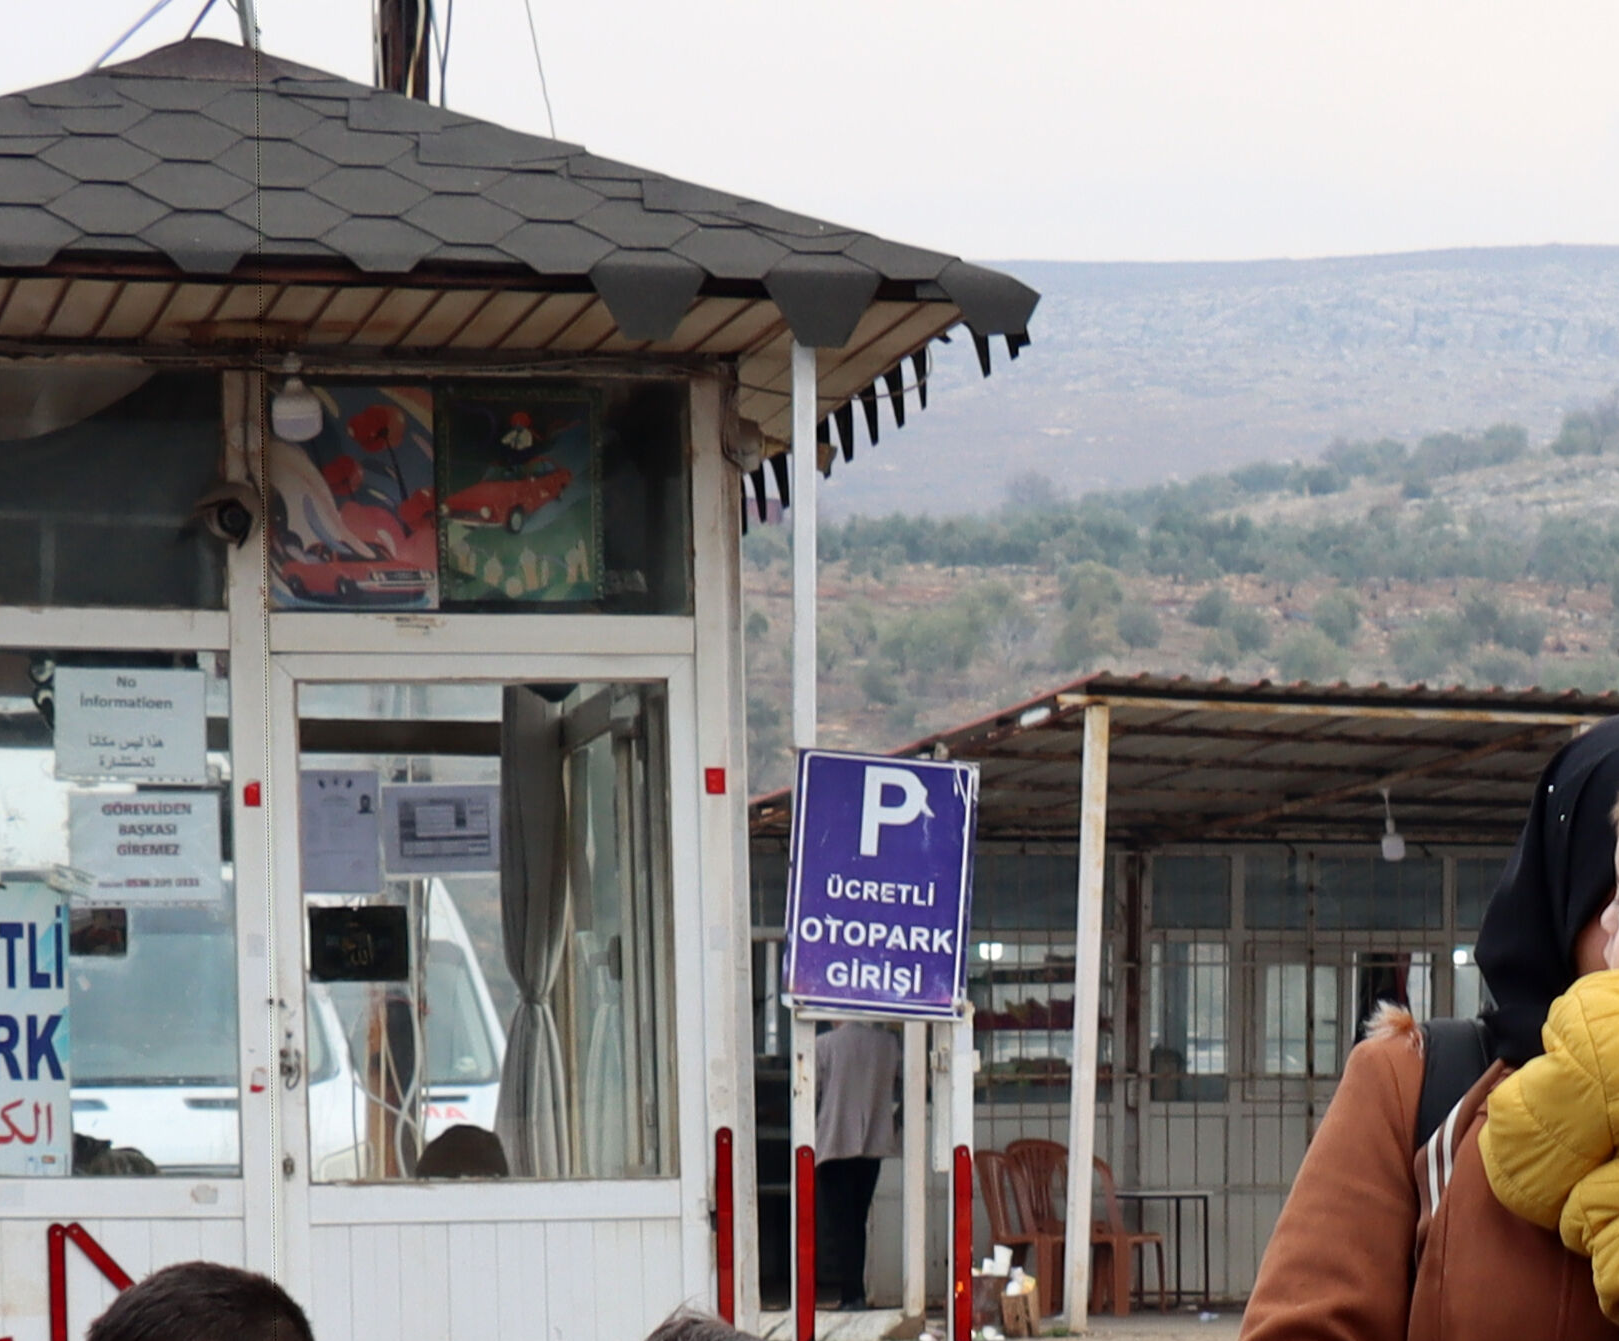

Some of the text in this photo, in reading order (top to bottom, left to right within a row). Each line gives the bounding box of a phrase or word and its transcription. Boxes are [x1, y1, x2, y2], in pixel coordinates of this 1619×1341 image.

[116, 675, 137, 689] No
[859, 765, 930, 857] P
[826, 872, 936, 908] ÜCRETLİ
[800, 913, 954, 955] OTOPARK
[825, 957, 923, 996] GİRİŞİ
